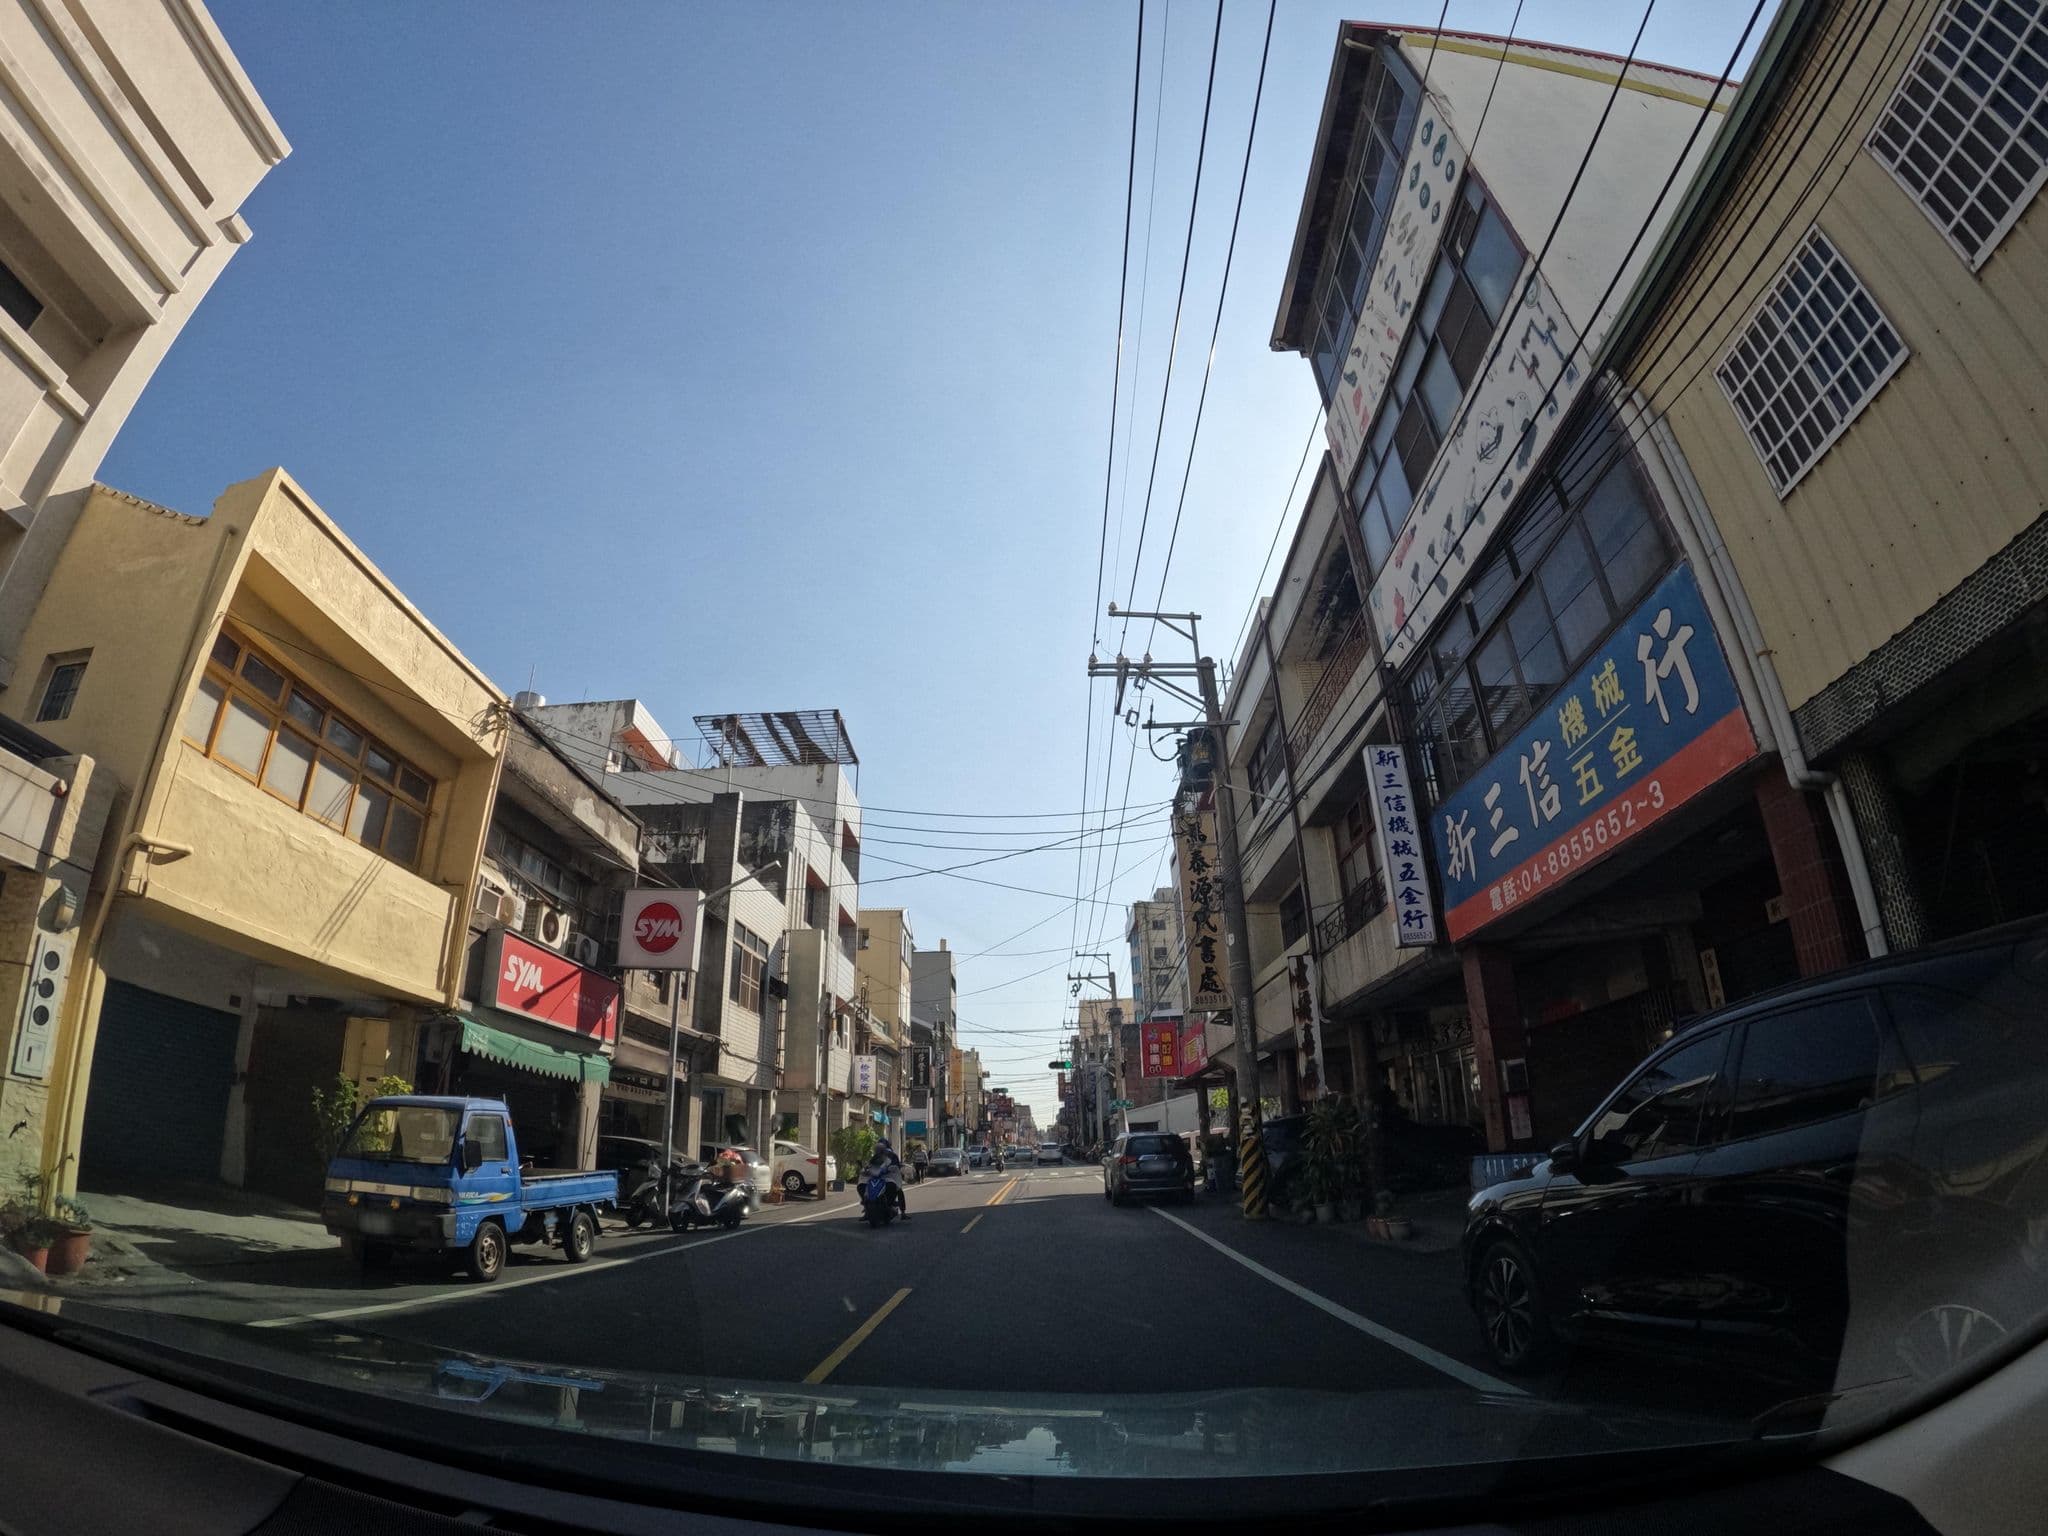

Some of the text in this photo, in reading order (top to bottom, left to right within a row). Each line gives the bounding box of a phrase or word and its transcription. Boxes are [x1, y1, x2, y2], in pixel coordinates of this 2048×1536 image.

[1446, 608, 1700, 882] 新三信 機械 五金 行
[1375, 750, 1429, 930] 新三信機械五金行
[504, 954, 544, 993] SYM
[633, 918, 682, 943] SYM
